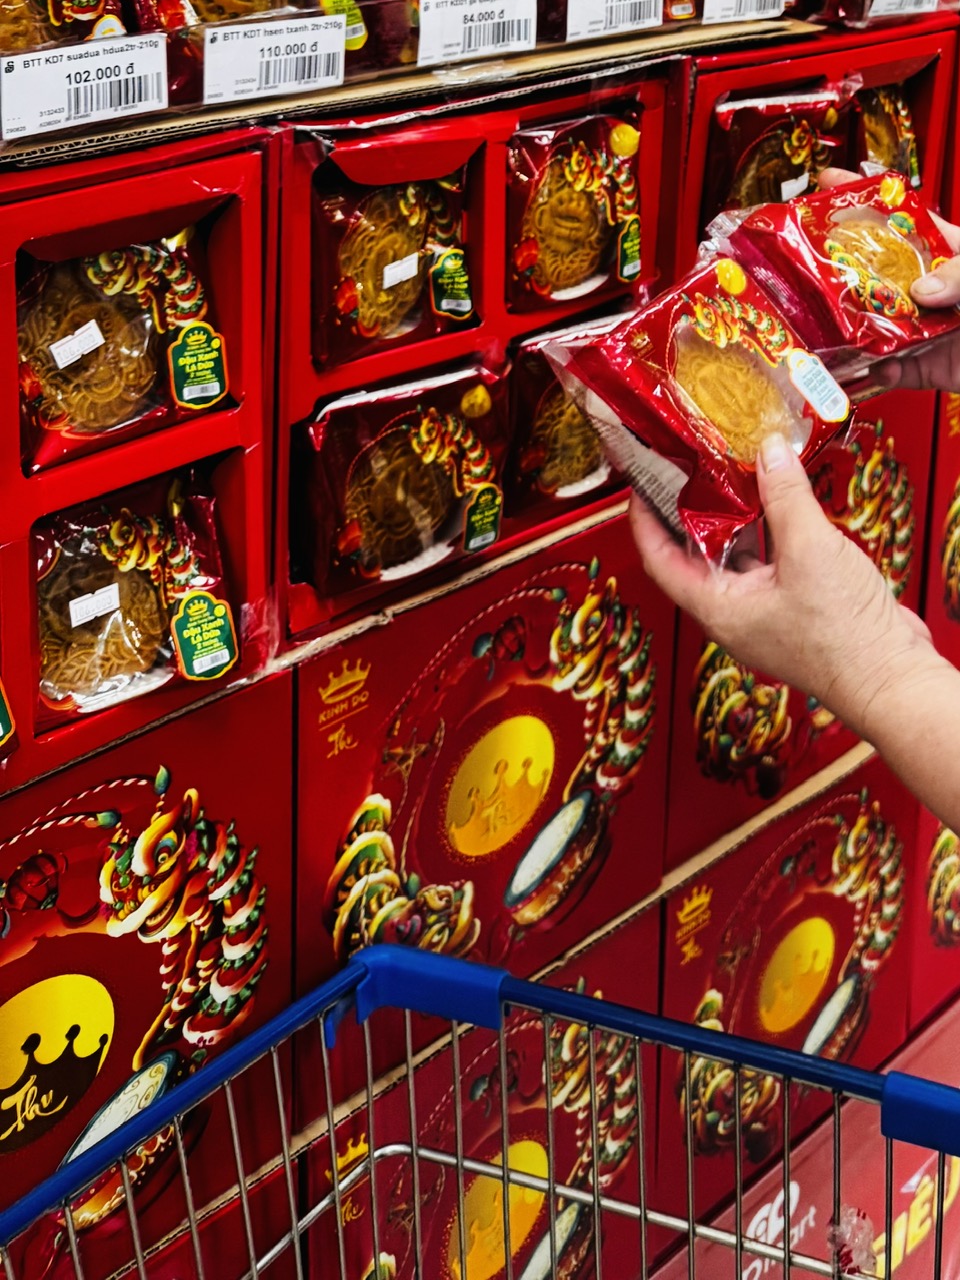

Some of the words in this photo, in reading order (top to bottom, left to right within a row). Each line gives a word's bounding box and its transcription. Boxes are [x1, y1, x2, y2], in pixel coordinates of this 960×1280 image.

[223, 31, 241, 41] BTT
[23, 57, 43, 69] BTT
[66, 49, 101, 62] suadua
[259, 42, 307, 59] 110.000
[310, 41, 319, 53] đ
[65, 64, 122, 86] 102.000
[125, 62, 135, 75] đ
